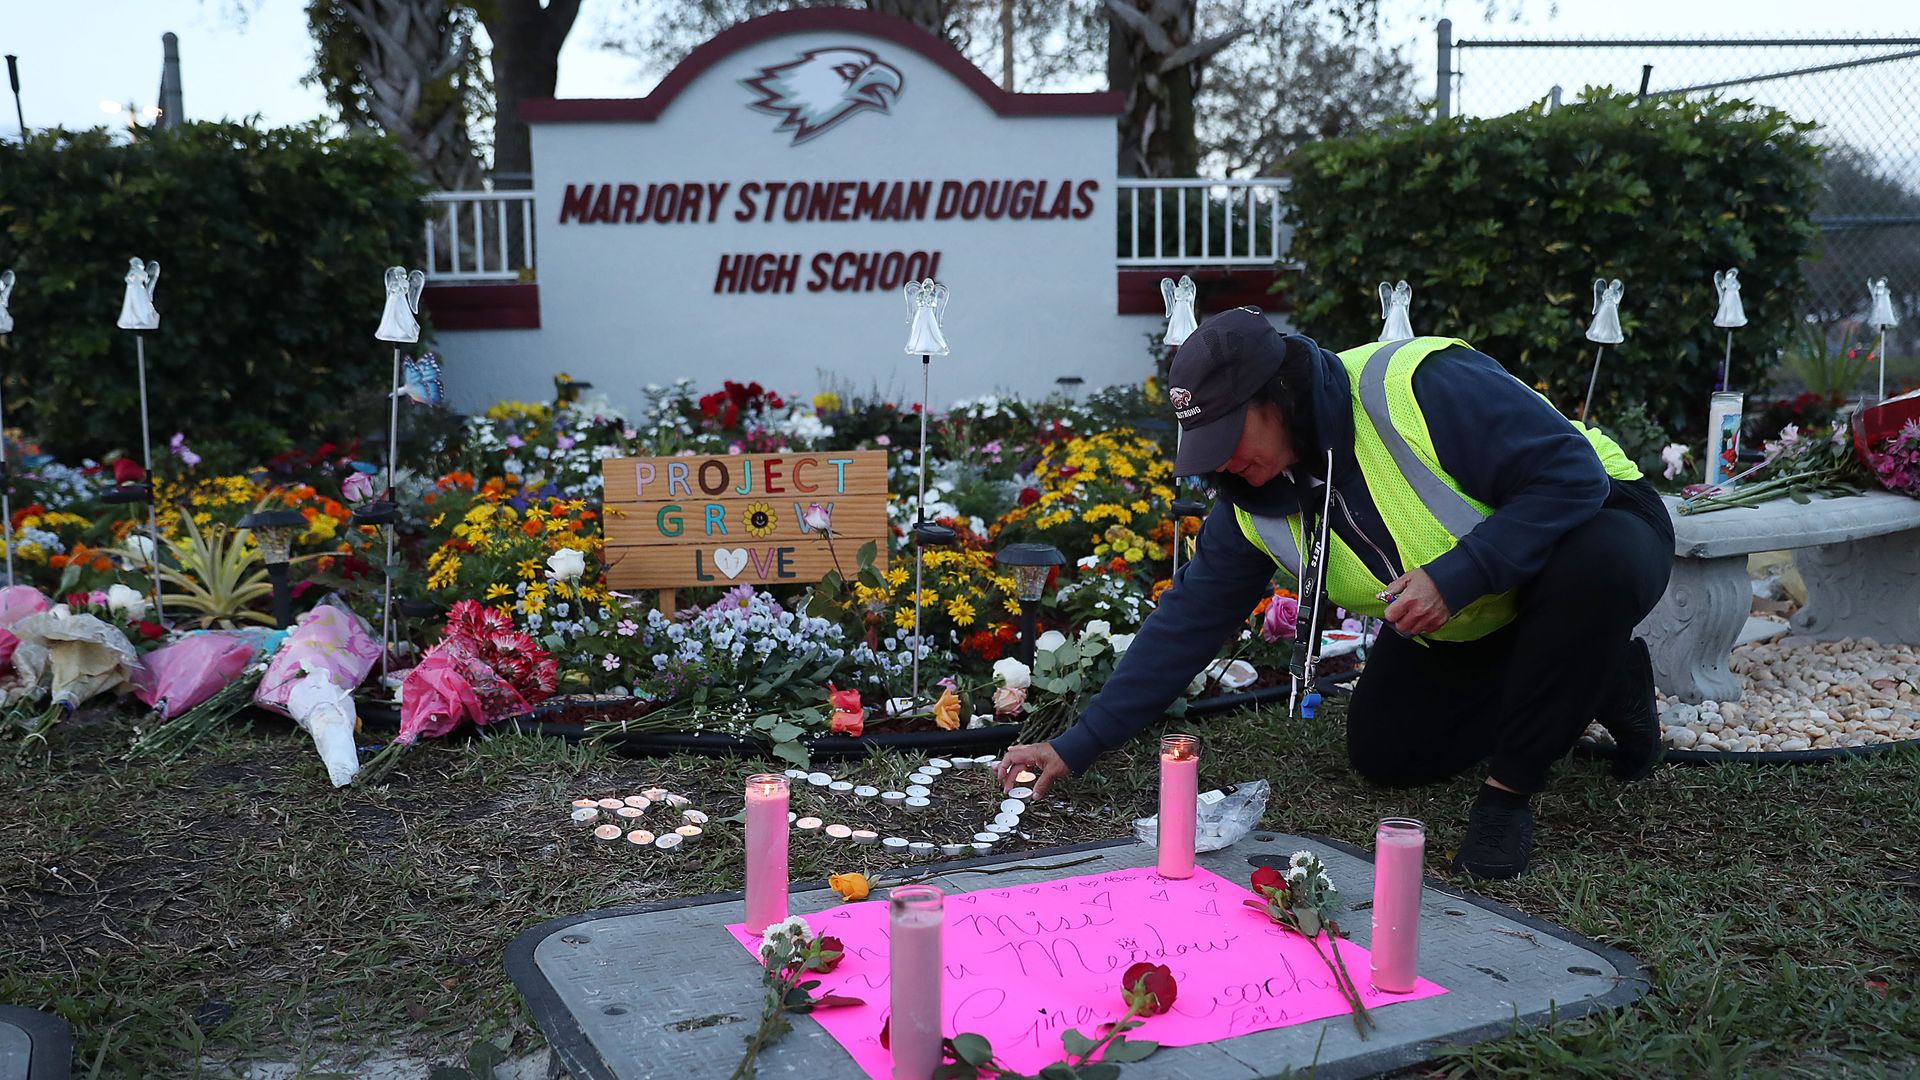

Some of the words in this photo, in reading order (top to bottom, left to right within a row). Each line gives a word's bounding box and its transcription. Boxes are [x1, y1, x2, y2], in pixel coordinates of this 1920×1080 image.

[559, 182, 730, 225] MARJORY
[734, 181, 934, 222] STONEMAN
[934, 180, 1100, 221] DOUGLAS
[713, 254, 801, 294] HIGH
[634, 458, 854, 497] PROJECT
[953, 911, 1113, 936] Miss
